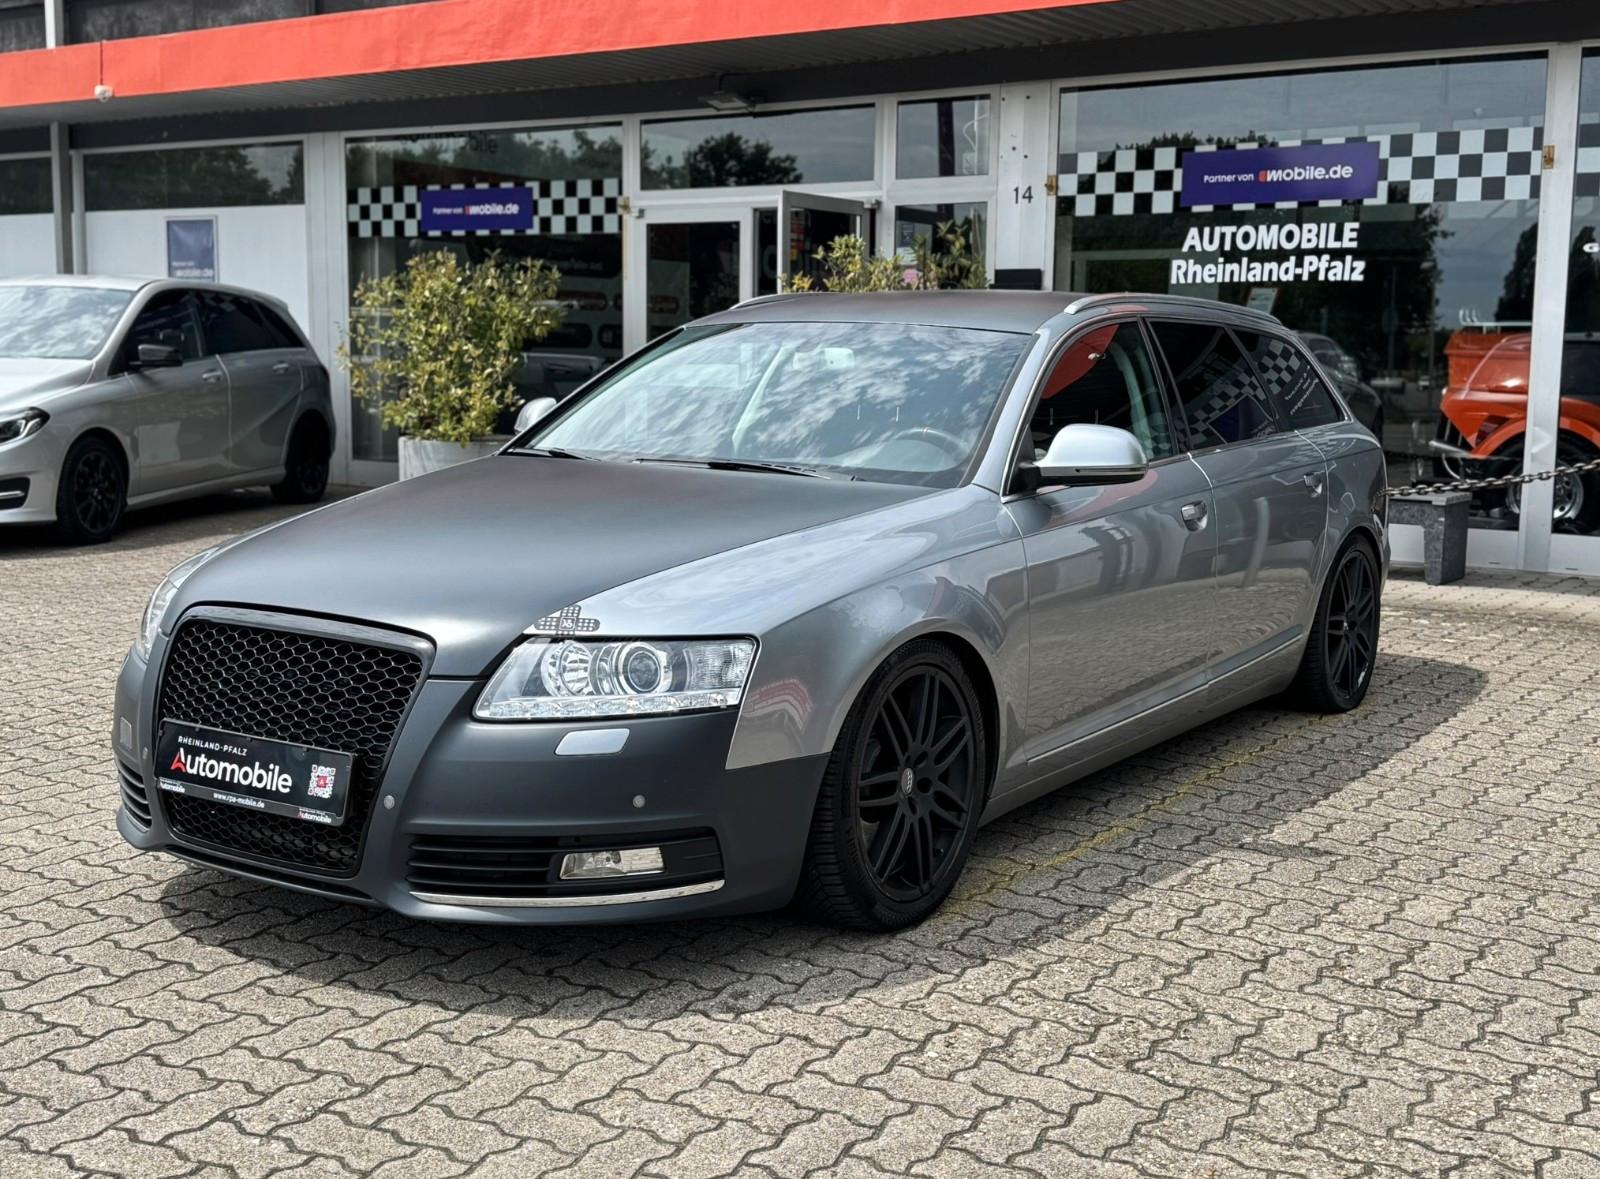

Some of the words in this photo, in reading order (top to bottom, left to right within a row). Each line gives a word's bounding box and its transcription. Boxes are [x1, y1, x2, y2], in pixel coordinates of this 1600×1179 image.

[1203, 172, 1236, 183] Partner
[1237, 173, 1254, 182] von
[1259, 165, 1353, 183] mobile.de
[1013, 185, 1034, 205] 14
[465, 203, 519, 215] mobile.de
[1182, 222, 1360, 252] AUTOMOBILE
[1170, 254, 1366, 284] Rheinland-Pfalz
[177, 736, 248, 756] RHEINLAND-PFALZ
[170, 747, 293, 793] Automobile
